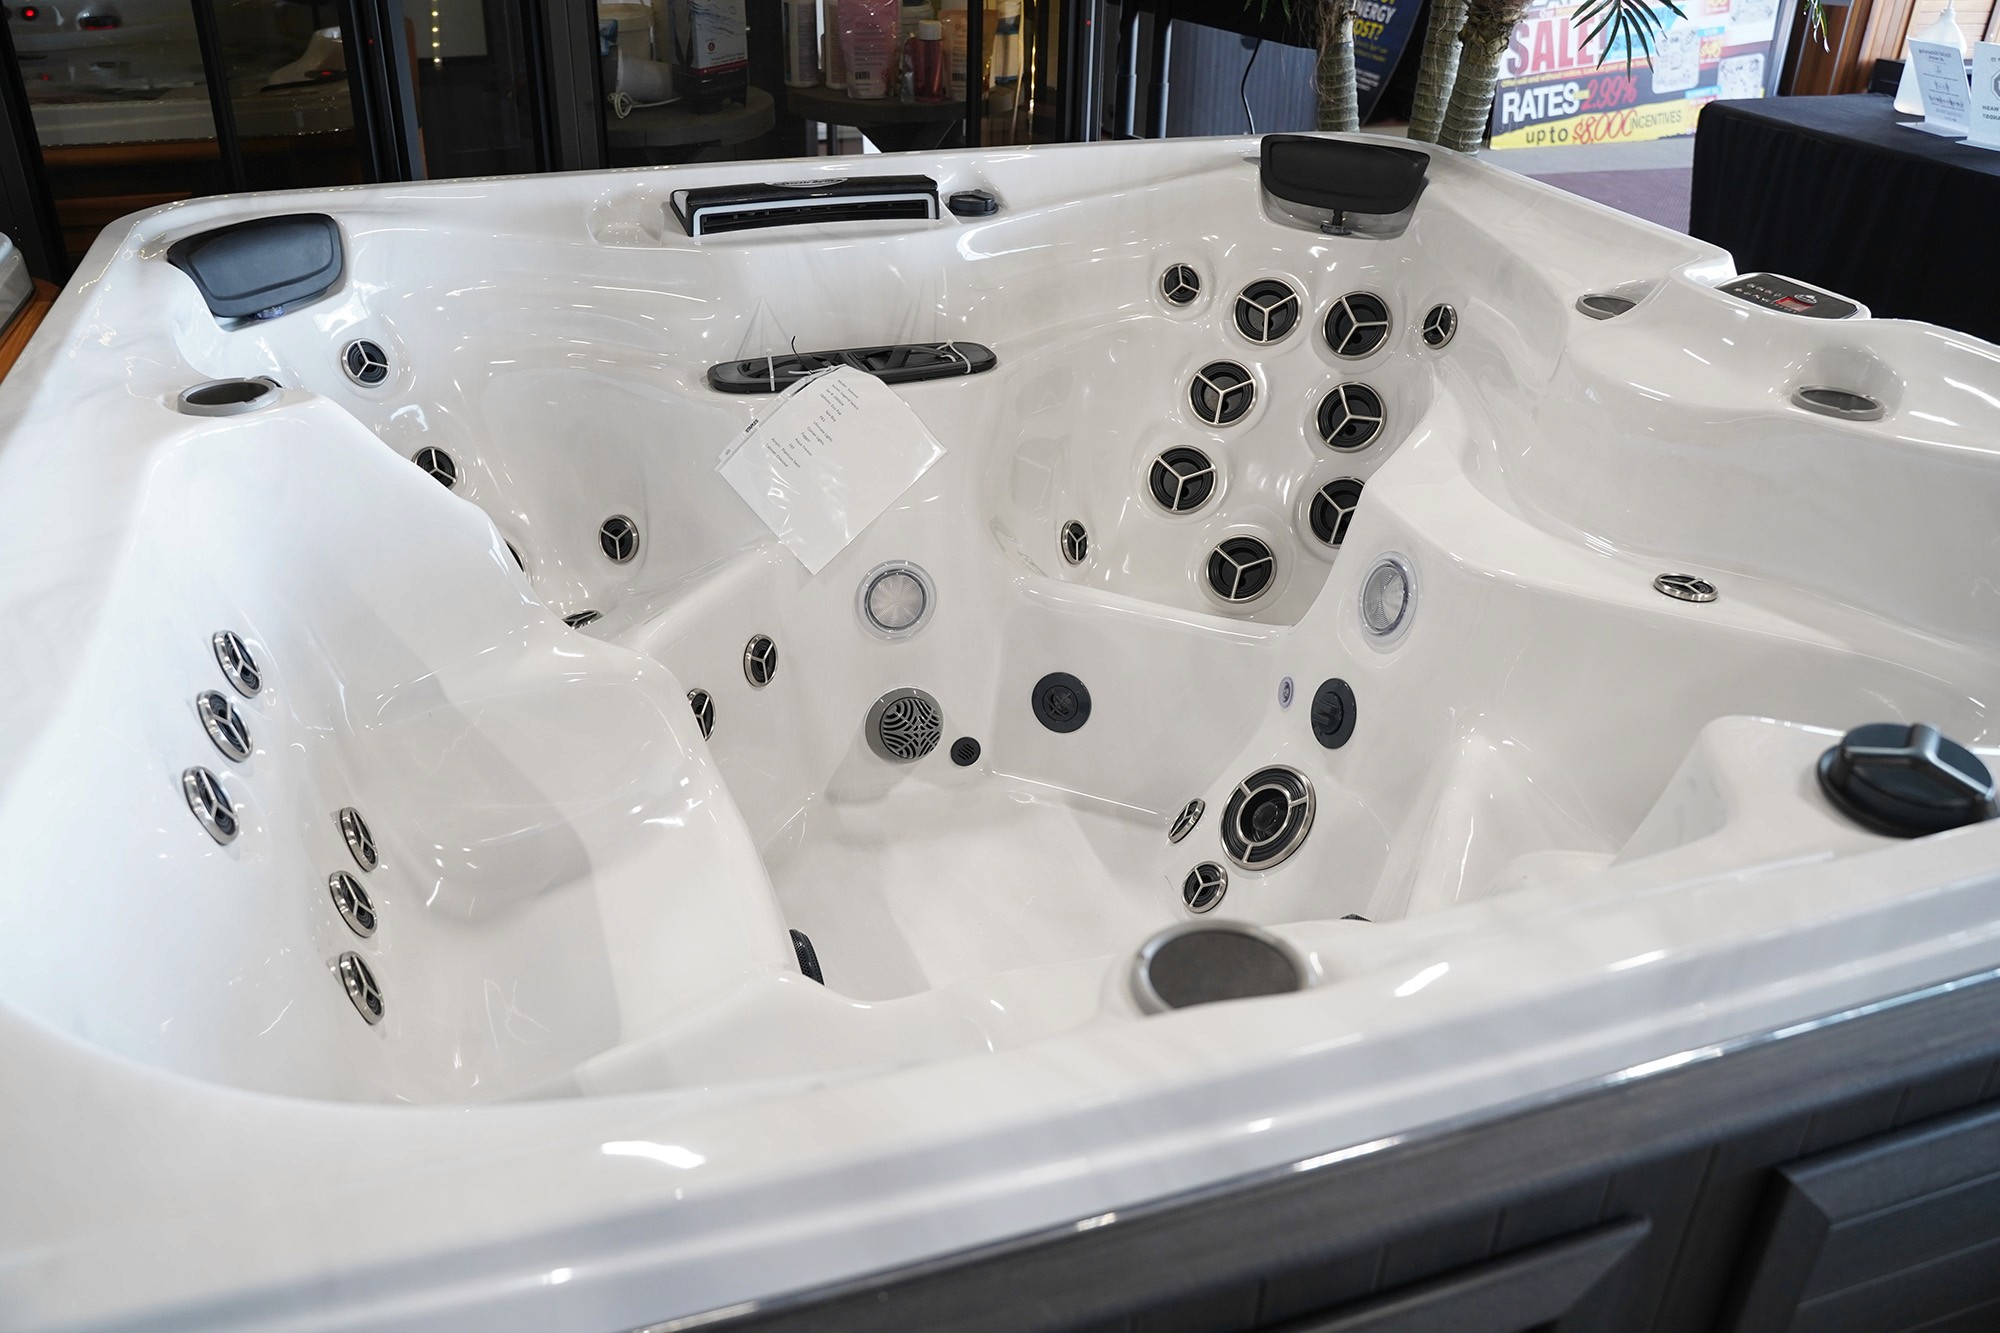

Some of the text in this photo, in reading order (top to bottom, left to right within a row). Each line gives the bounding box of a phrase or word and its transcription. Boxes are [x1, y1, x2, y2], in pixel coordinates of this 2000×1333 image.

[1355, 0, 1397, 24] NERGY
[1353, 18, 1384, 41] OST?
[1502, 81, 1580, 124] RATES
[1581, 75, 1637, 111] 2.99%
